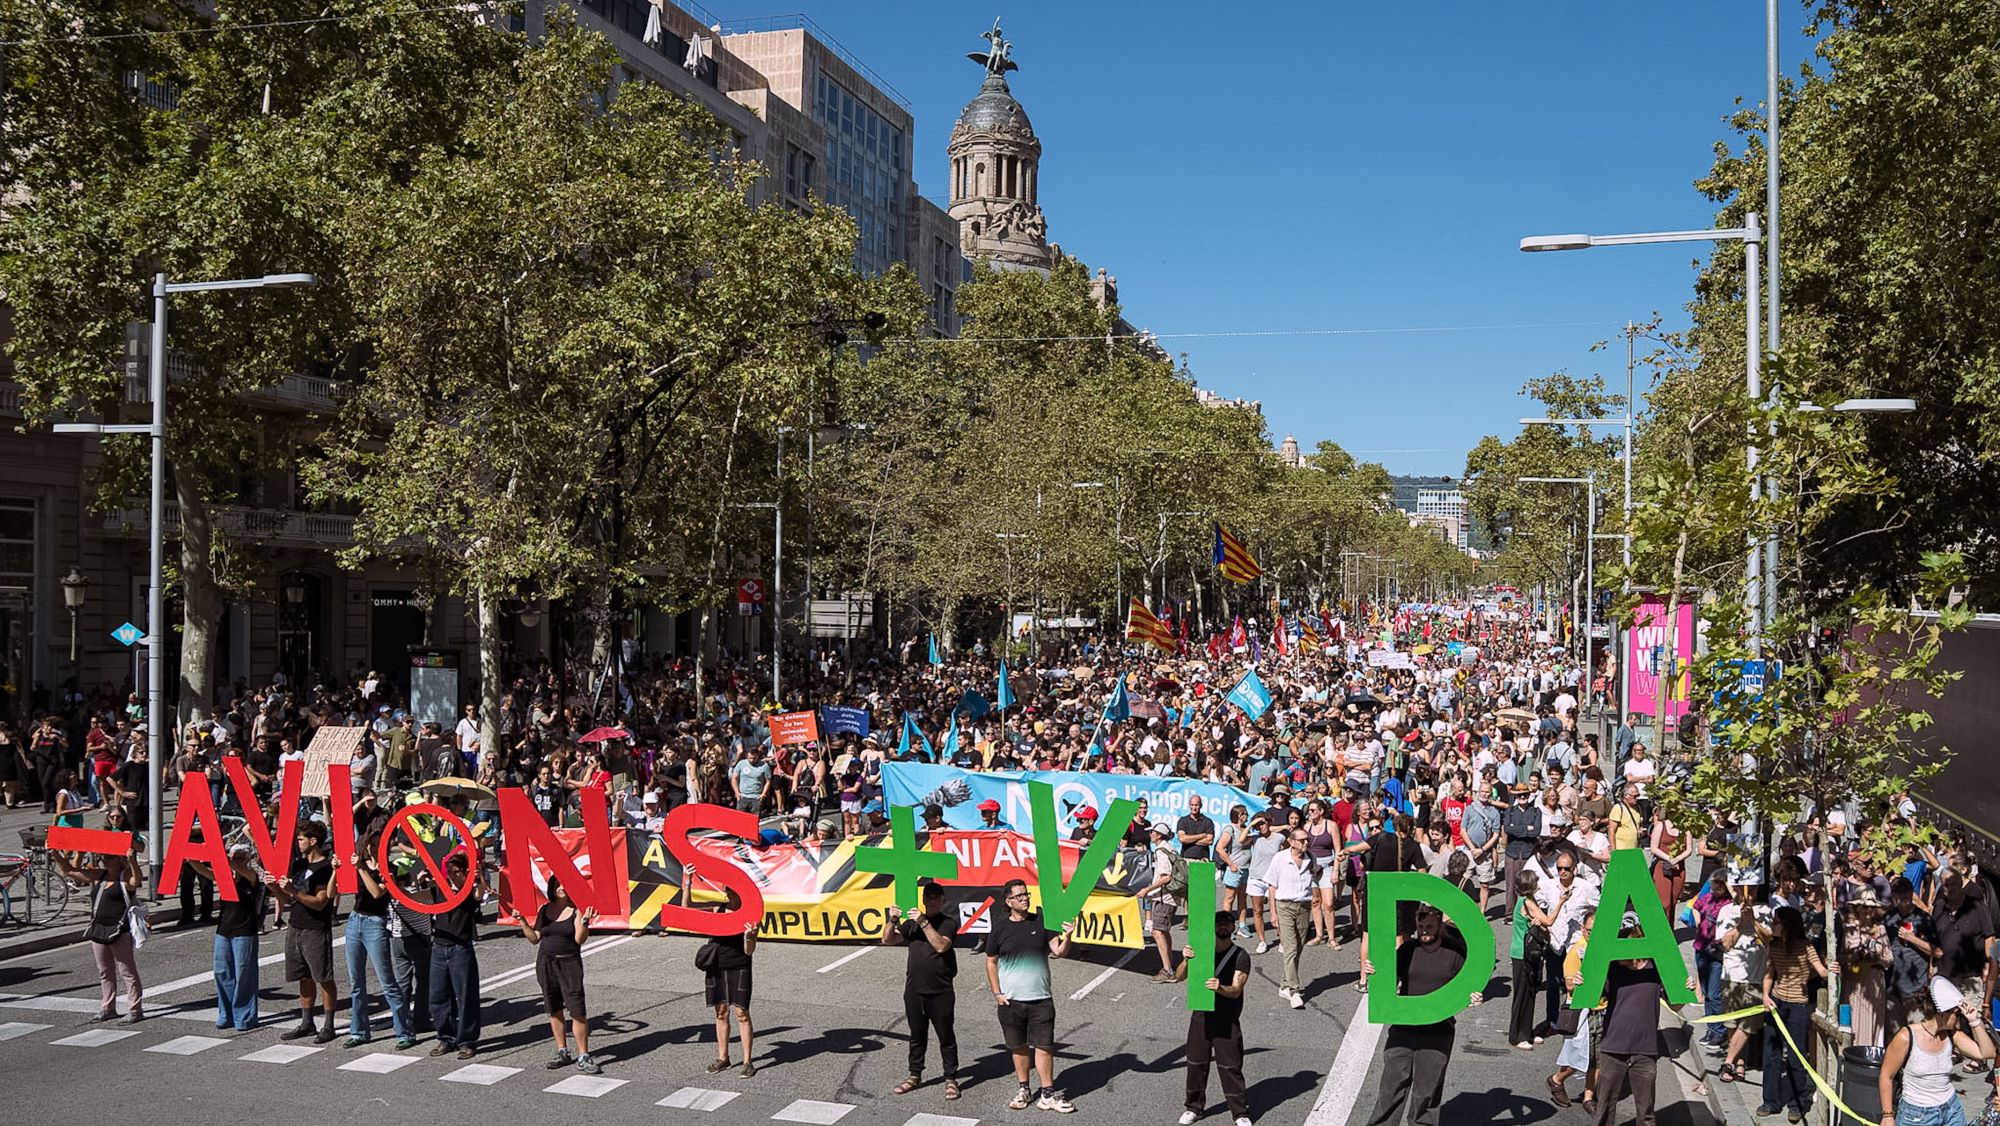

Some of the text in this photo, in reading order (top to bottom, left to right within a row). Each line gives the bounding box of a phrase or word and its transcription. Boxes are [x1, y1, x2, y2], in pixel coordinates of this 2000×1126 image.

[944, 838, 981, 868] NI
[992, 838, 1038, 869] AR
[1076, 911, 1124, 943] MAI
